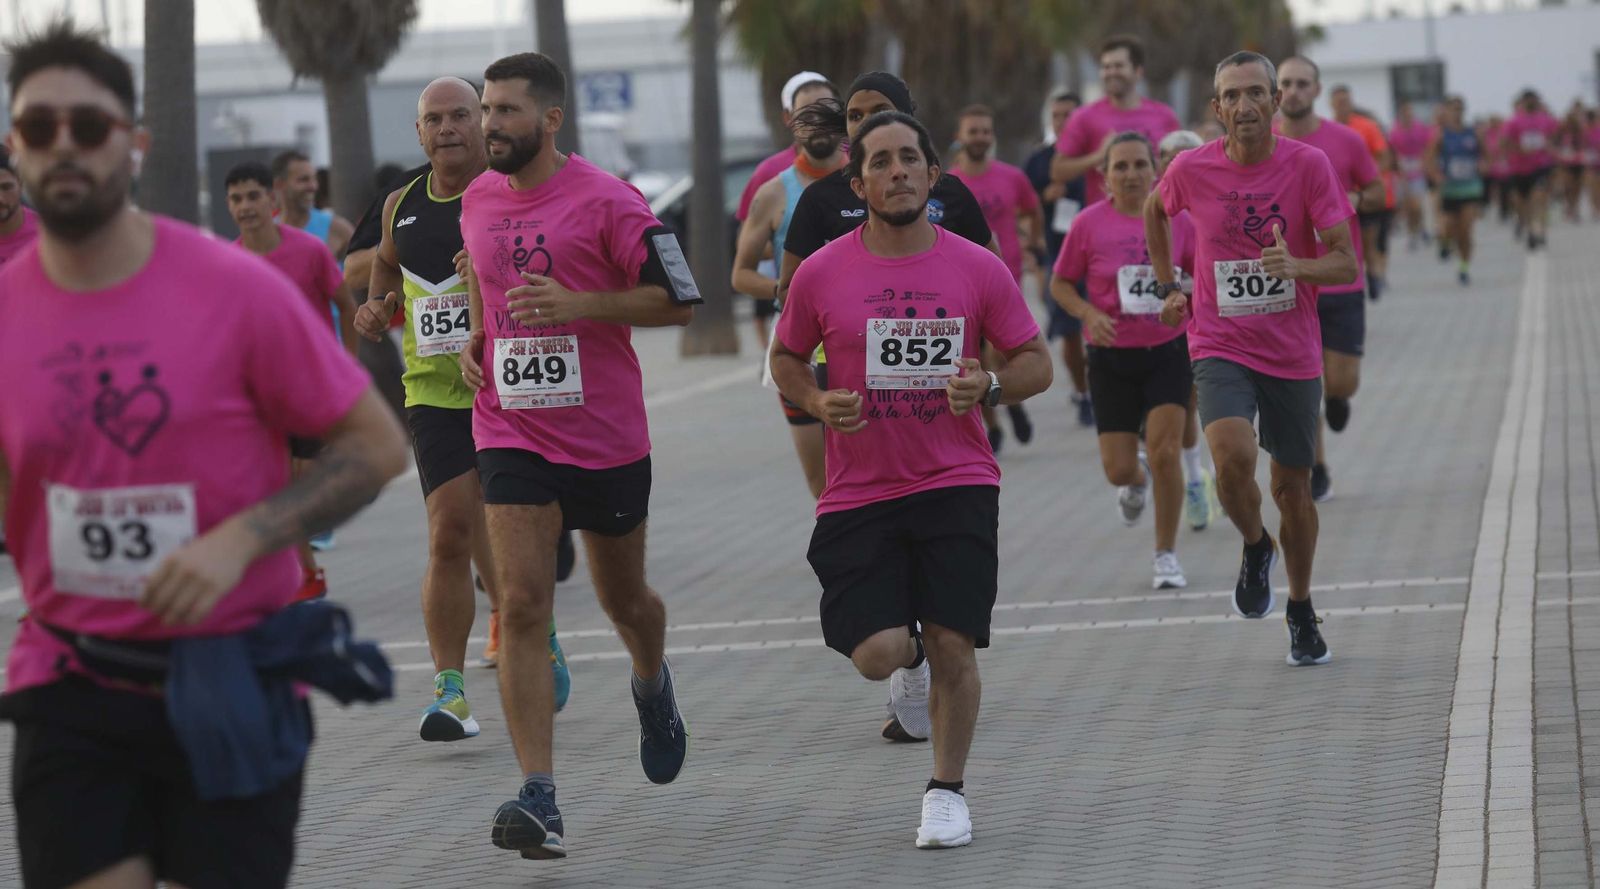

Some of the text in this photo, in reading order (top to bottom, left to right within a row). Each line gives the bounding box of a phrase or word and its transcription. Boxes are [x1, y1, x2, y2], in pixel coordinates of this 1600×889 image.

[1227, 275, 1285, 298] 302
[421, 308, 470, 337] 854
[891, 327, 960, 336] POR LA MUJER
[916, 320, 958, 329] CARRERA
[509, 344, 574, 356] POR LA MUJER
[880, 338, 952, 367] 852
[502, 355, 567, 387] 849
[82, 520, 155, 561] 93
